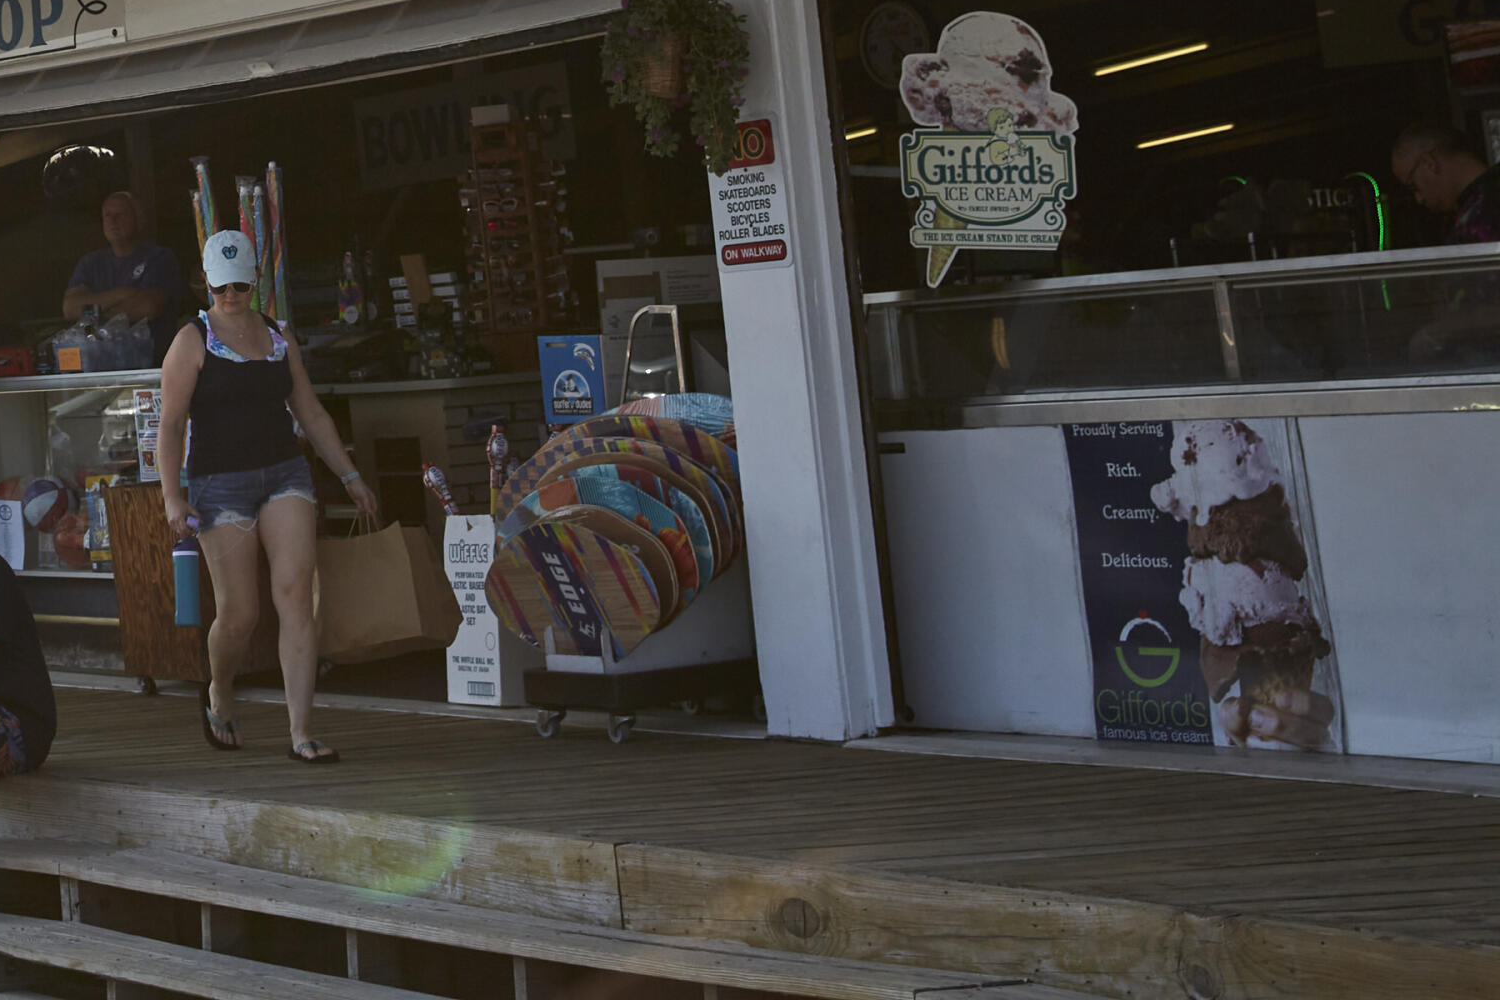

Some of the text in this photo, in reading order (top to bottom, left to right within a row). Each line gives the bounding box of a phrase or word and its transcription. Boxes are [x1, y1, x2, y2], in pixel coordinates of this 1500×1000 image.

[363, 87, 569, 167] BOWLG
[917, 145, 1055, 186] Gifford's
[726, 171, 766, 187] SMOKING
[718, 184, 777, 201] SKATEBOARDS
[944, 187, 1034, 202] ICE CREAM
[726, 198, 771, 213] SCOOTERS
[730, 211, 770, 227] BICYCLES
[719, 224, 785, 241] ROLLER BLADES
[922, 232, 939, 242] THE
[941, 232, 954, 242] ICE
[955, 233, 985, 242] CREAM
[986, 233, 1013, 243] STAND
[1015, 233, 1029, 243] ICE
[724, 244, 784, 261] ON WALKWAY
[1071, 422, 1165, 439] Proudly Serving
[1105, 462, 1142, 477] Rich.
[1102, 504, 1160, 524] Creamy.
[1101, 552, 1173, 569] Delicious.
[465, 616, 477, 626] SET
[1096, 688, 1209, 728] Gifford's
[1102, 725, 1210, 744] famous ice cream
